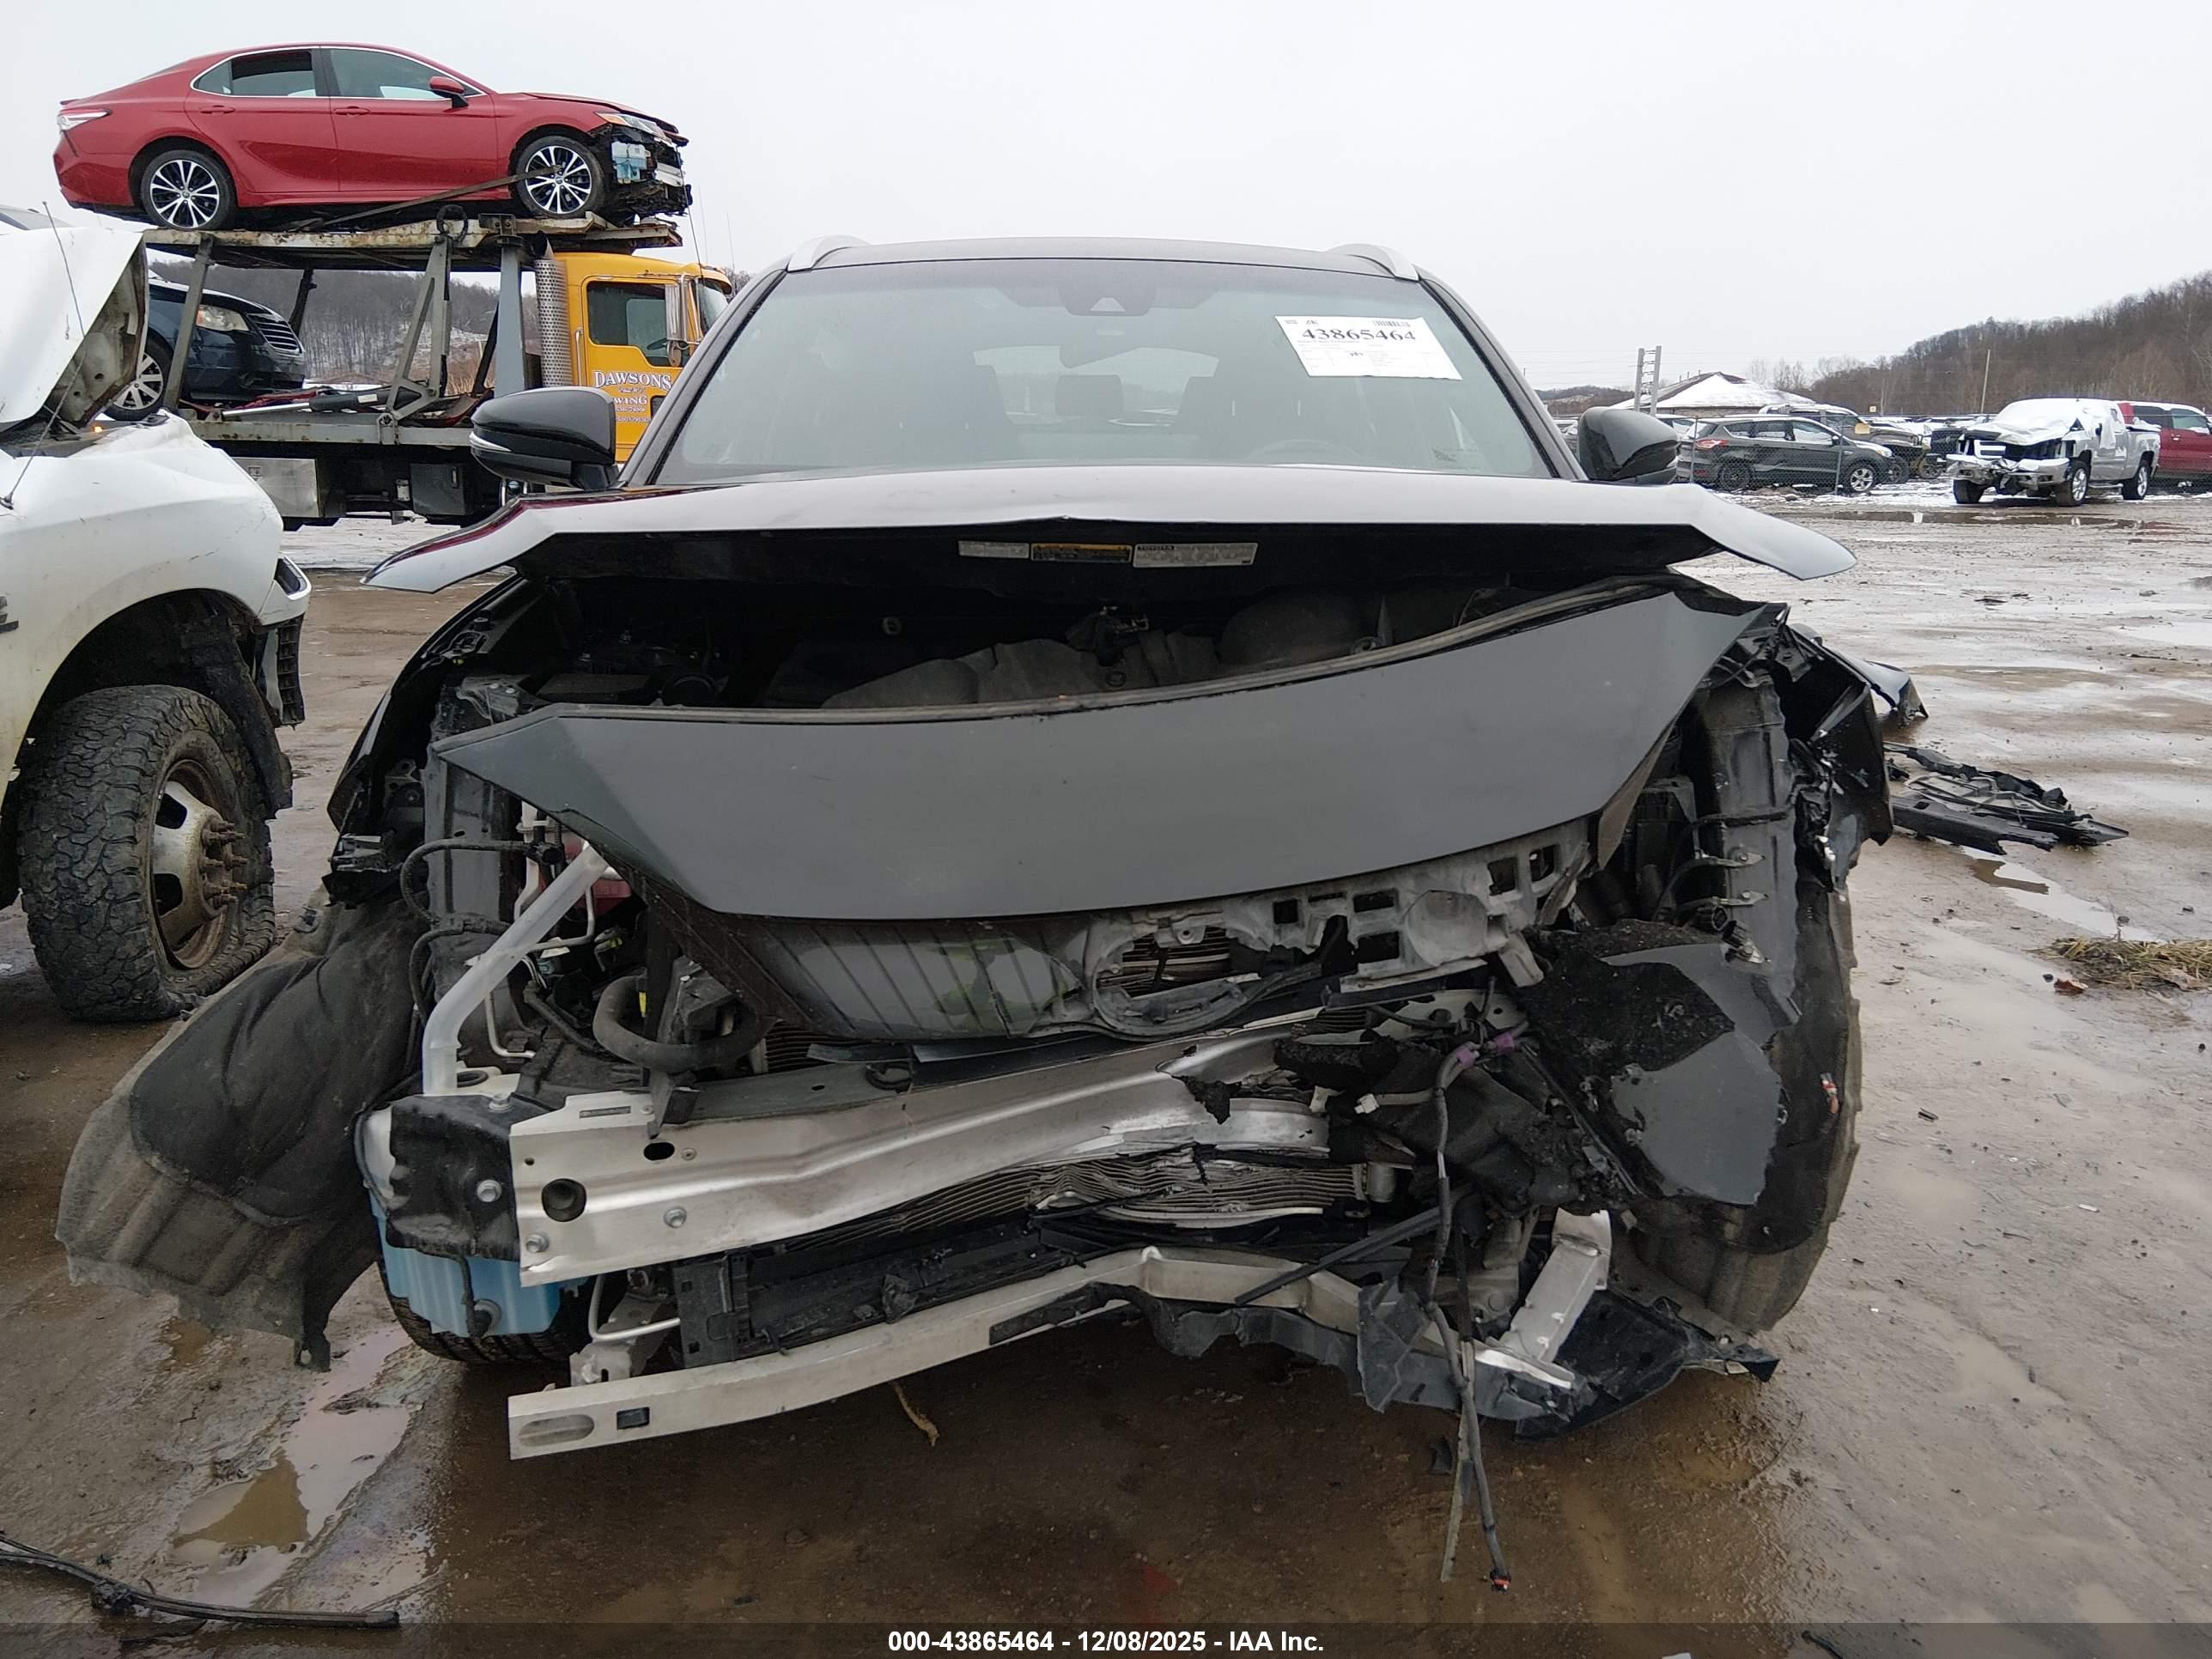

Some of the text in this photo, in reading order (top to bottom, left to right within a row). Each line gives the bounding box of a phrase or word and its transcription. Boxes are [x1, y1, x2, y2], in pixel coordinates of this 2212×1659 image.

[1302, 329, 1416, 341] 43865464
[593, 370, 672, 392] DAWSONS
[613, 396, 648, 405] WING
